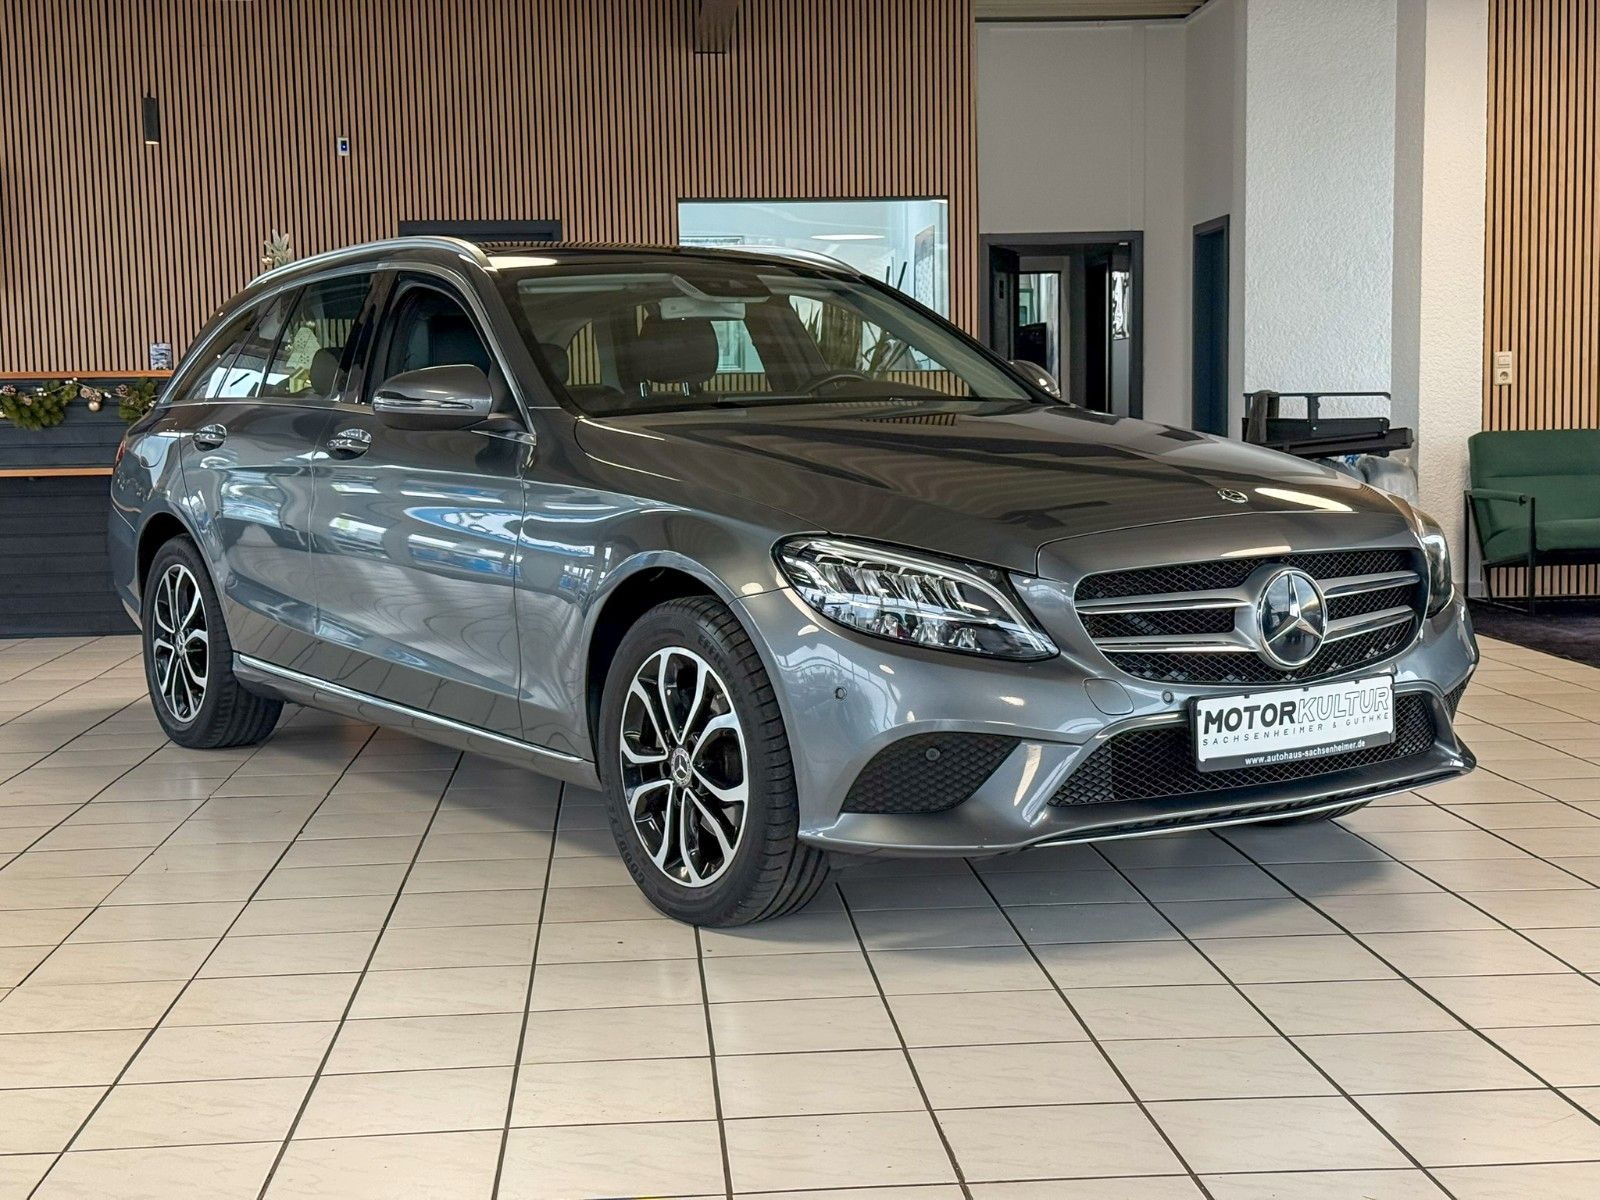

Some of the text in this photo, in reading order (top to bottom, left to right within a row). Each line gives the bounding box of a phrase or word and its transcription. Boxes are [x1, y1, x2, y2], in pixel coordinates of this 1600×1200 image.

[1203, 686, 1390, 735] MOTORKULTUR
[1202, 723, 1323, 746] SACHSENHEIMER
[1345, 711, 1389, 727] GUTHKE
[1244, 739, 1366, 765] www.autohaus-sachsenheimer.de
